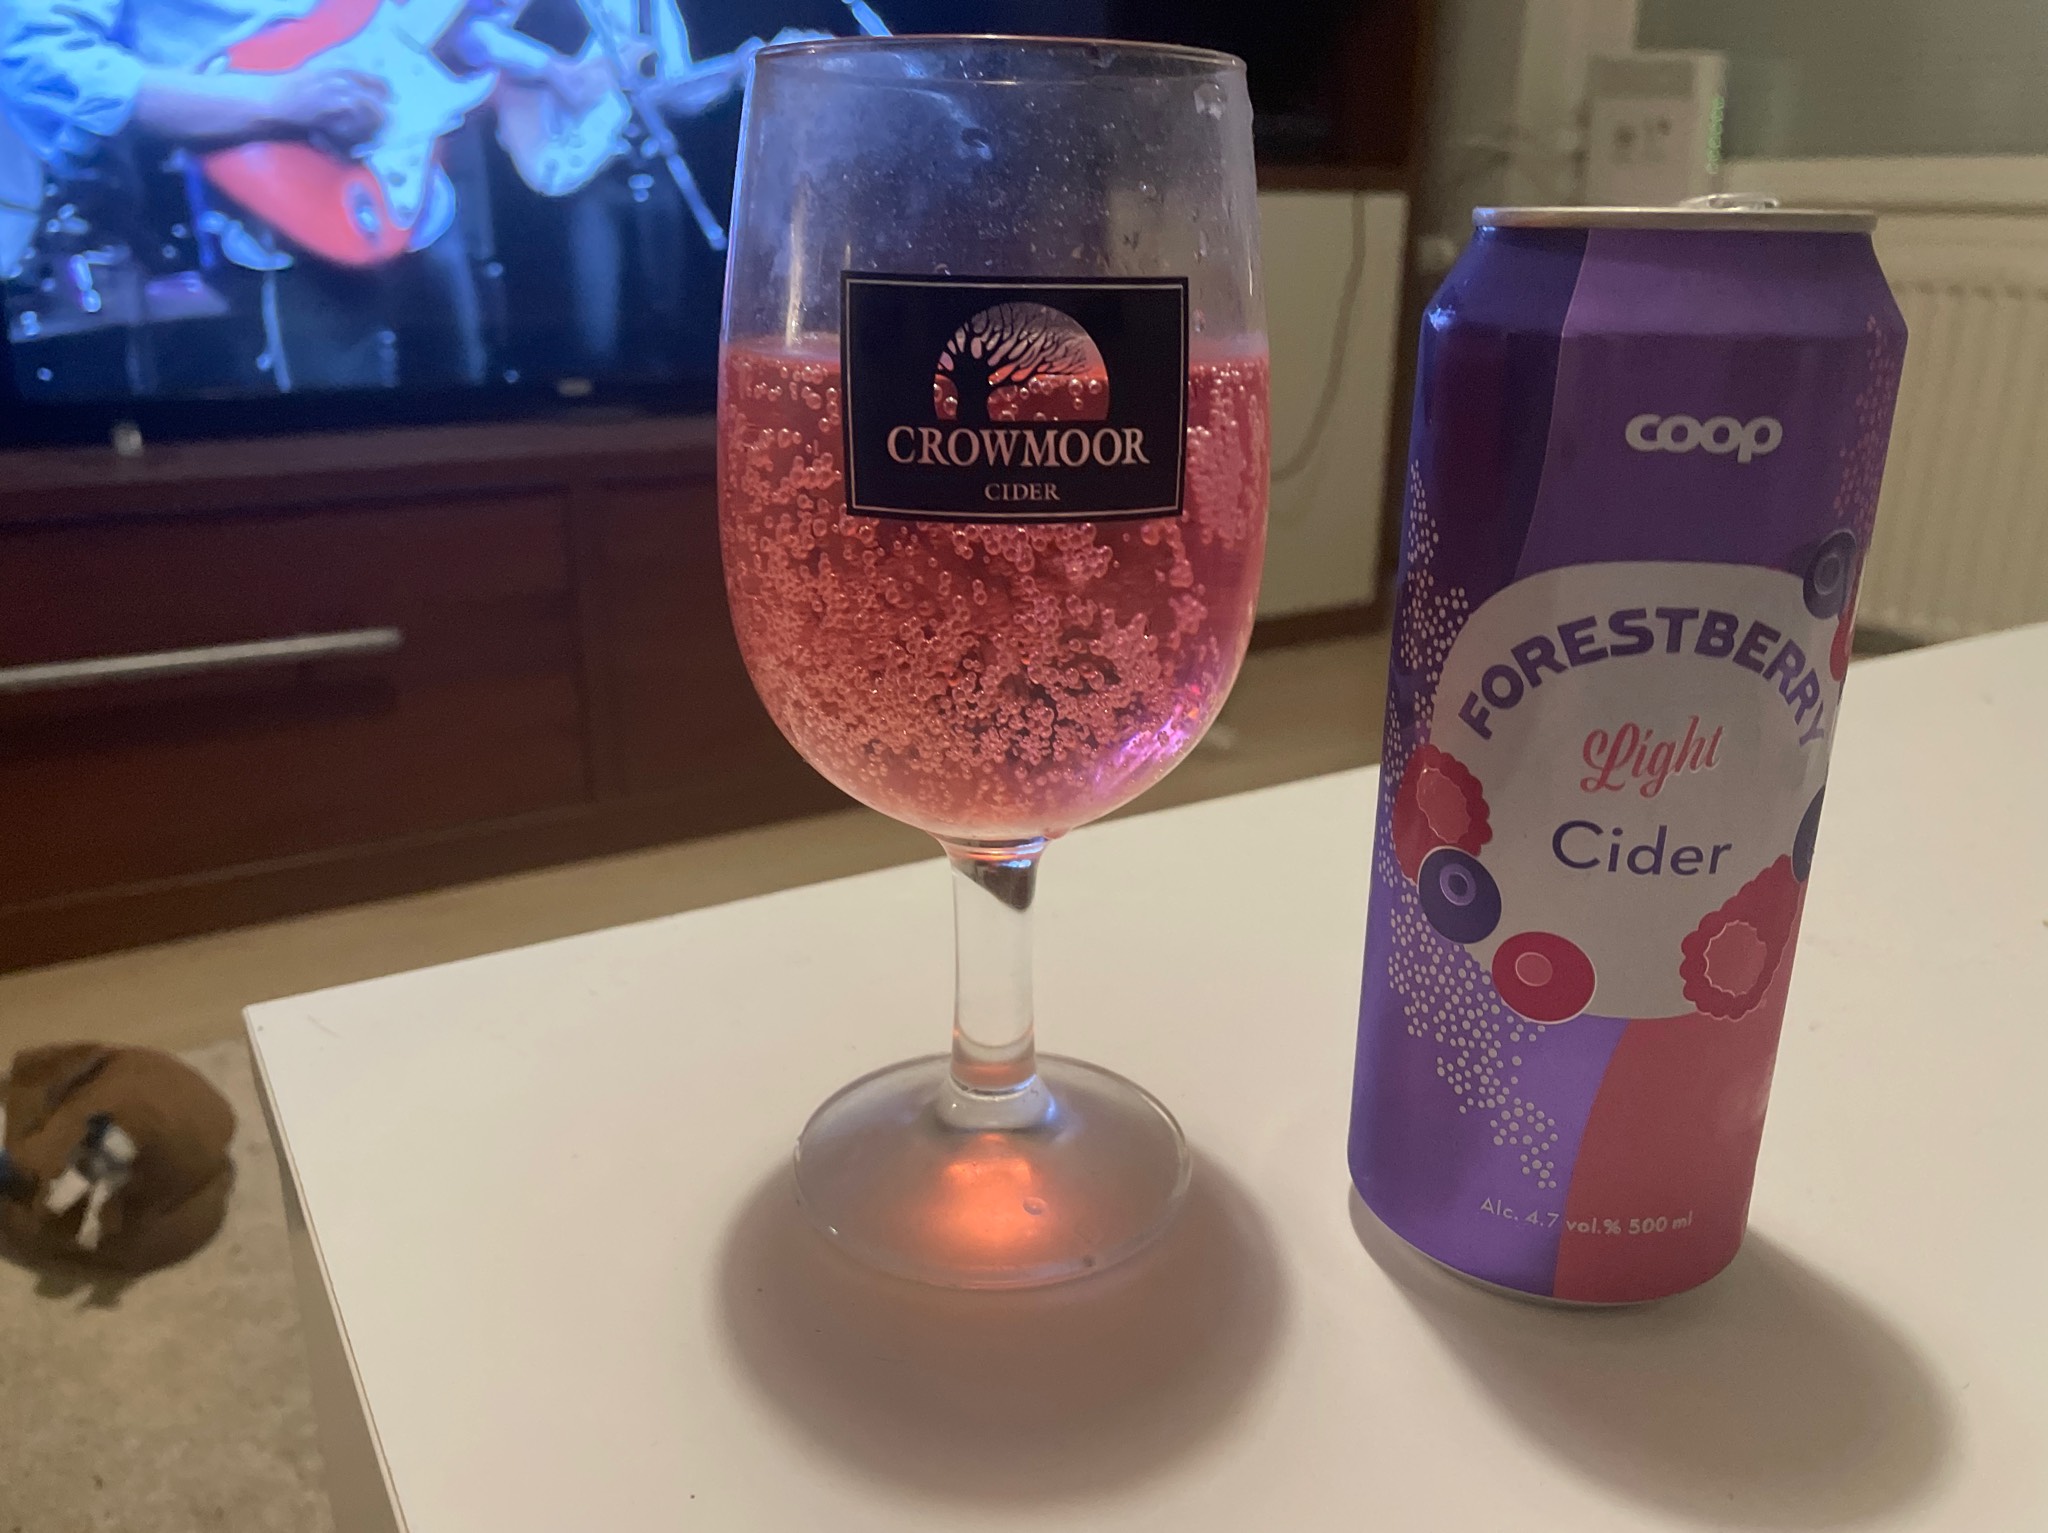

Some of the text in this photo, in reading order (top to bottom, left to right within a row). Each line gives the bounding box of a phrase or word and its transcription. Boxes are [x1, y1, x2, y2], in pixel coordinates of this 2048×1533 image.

[887, 425, 1150, 467] CROWMOOR
[1625, 413, 1783, 463] coop
[984, 482, 1060, 501] CIDER
[1457, 606, 1825, 746] FORESTBERRY
[1580, 715, 1724, 798] Light
[1552, 820, 1733, 876] Cider
[1480, 1197, 1694, 1235] Alc. 4.7 vol.% 500 ml
